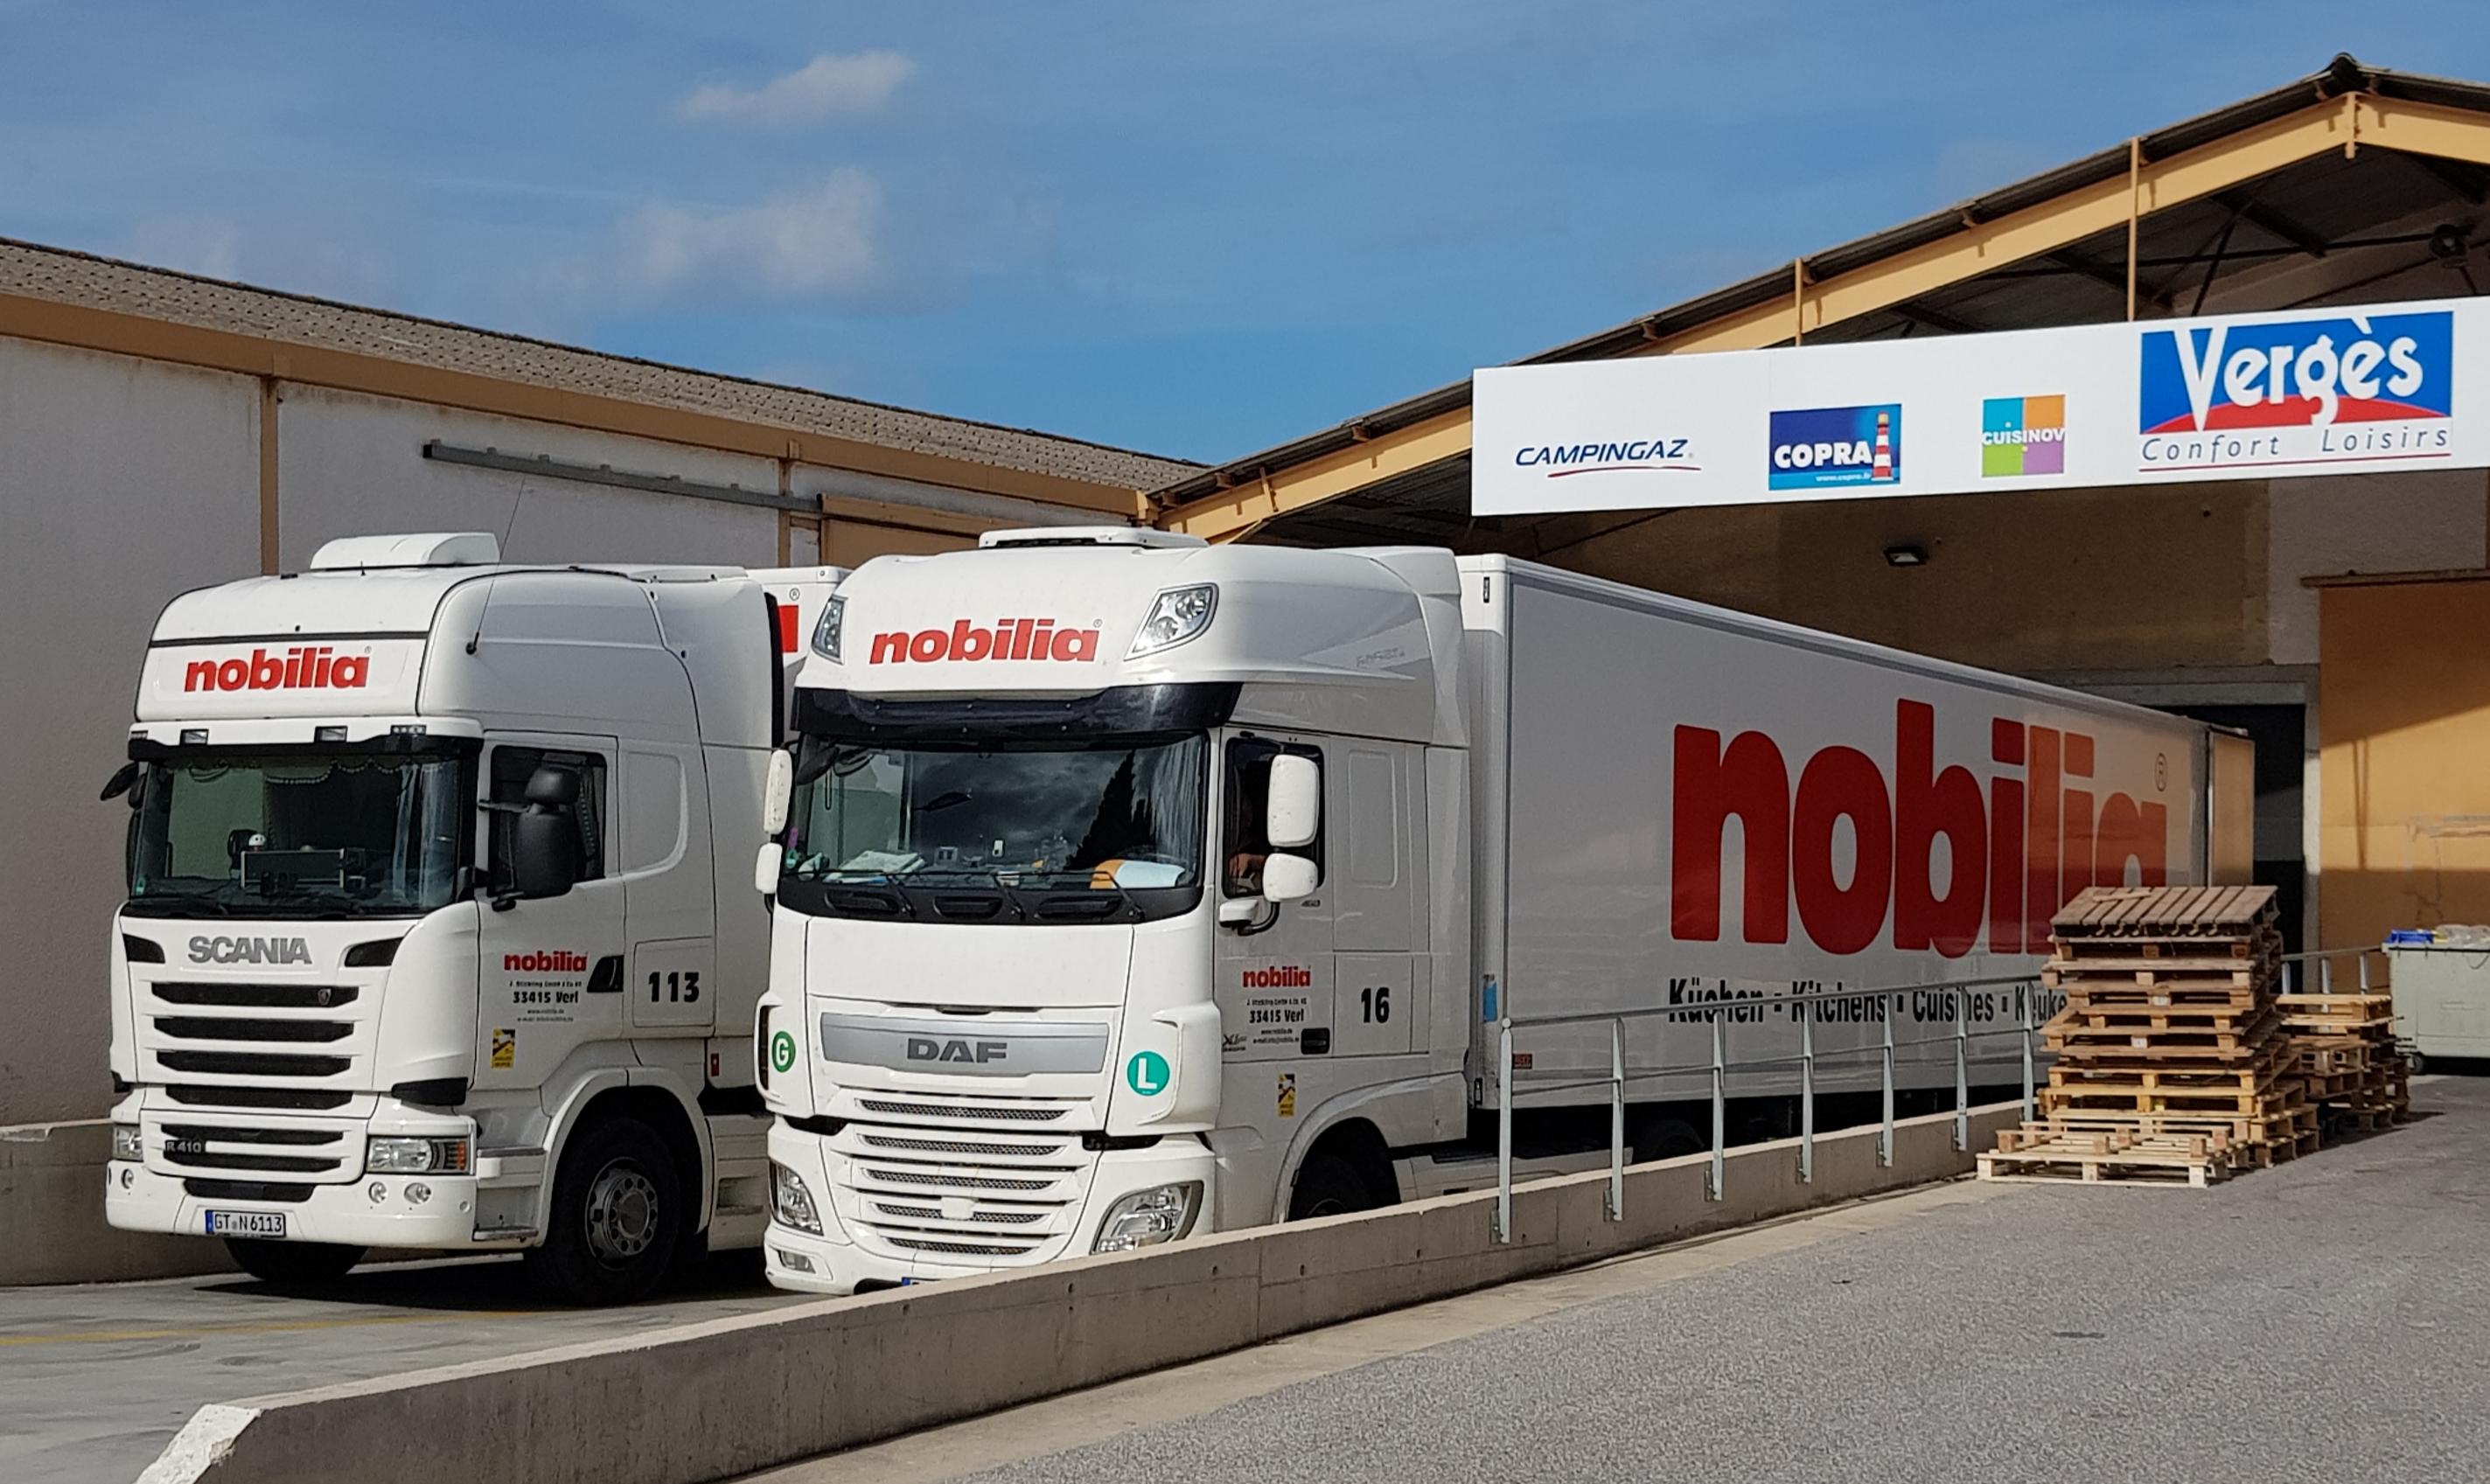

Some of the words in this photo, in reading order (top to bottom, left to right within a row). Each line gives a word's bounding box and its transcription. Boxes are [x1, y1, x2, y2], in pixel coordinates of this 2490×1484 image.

[2173, 317, 2424, 432] Vergès
[1516, 439, 1688, 466] CAMPINGAZ
[1774, 441, 1873, 469] COPRA
[2142, 434, 2280, 463] Confort
[2322, 426, 2448, 452] Loisirs
[869, 619, 1099, 664] nobilia
[185, 647, 370, 692] nobilia
[188, 936, 312, 964] SCANIA
[504, 950, 587, 972] nobilia
[648, 972, 700, 1003] 113
[1243, 965, 1310, 987] nobilia
[513, 991, 551, 1003] 33415
[556, 991, 578, 1003] Verl
[1361, 987, 1390, 1023] 16
[1670, 977, 1763, 1022] Küchen
[1249, 1009, 1281, 1023] 33415
[1285, 1008, 1304, 1022] Verl
[775, 1038, 789, 1066] G
[907, 1038, 1007, 1062] DAF
[1138, 1058, 1157, 1089] L
[166, 1142, 175, 1152] R
[177, 1142, 202, 1153] 410
[214, 1214, 230, 1230] GT
[239, 1216, 247, 1230] N
[250, 1216, 282, 1232] 6113
